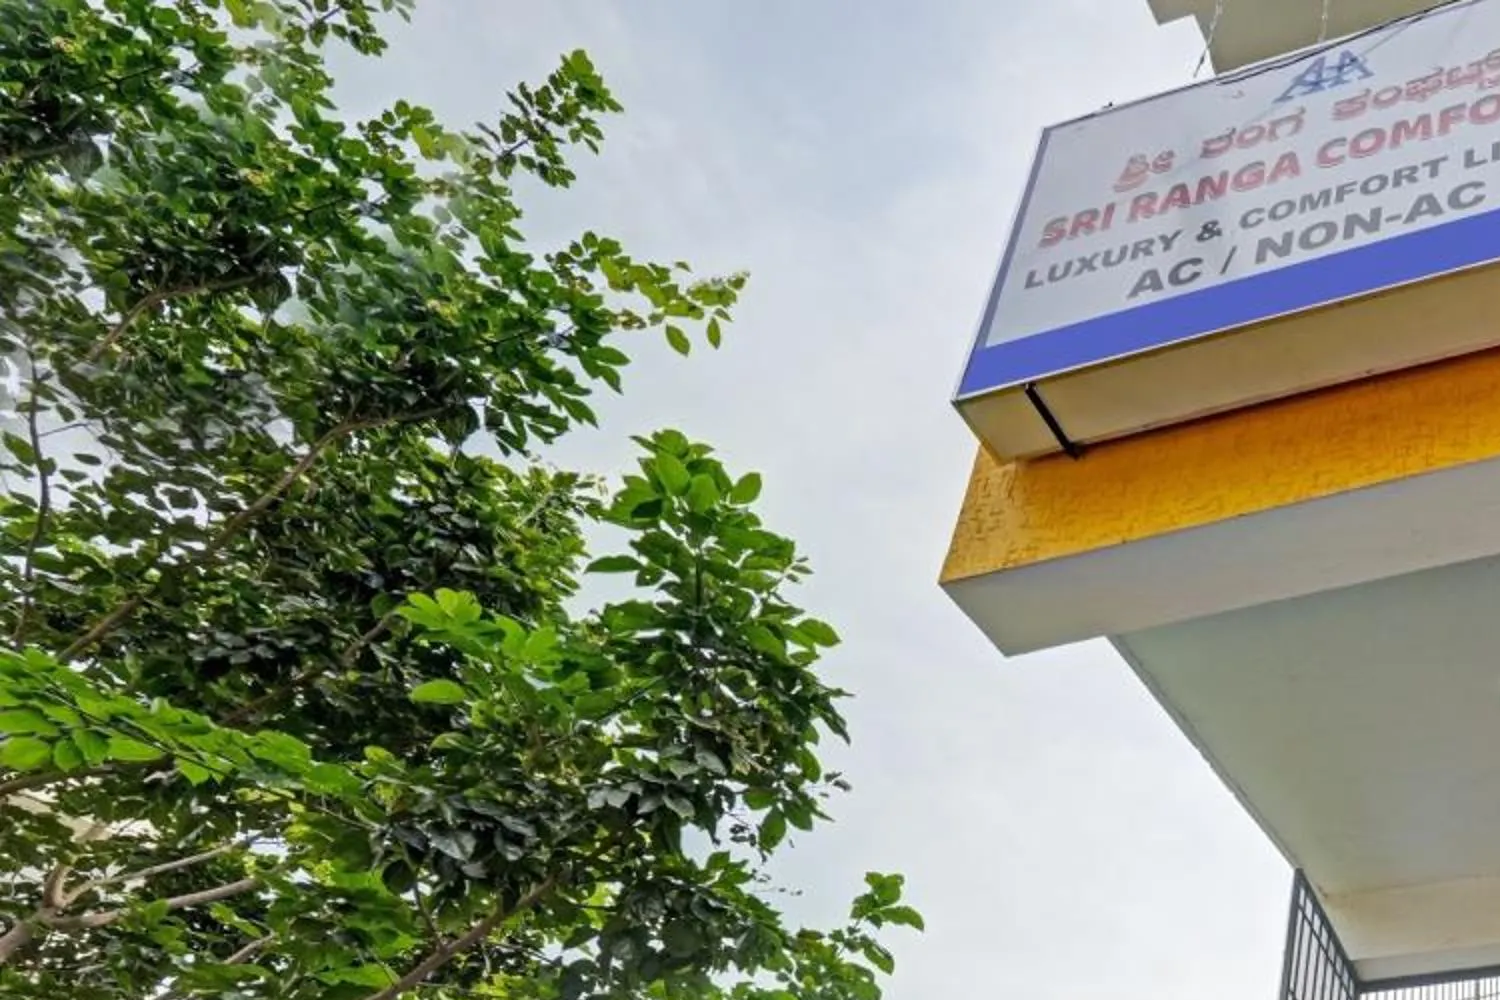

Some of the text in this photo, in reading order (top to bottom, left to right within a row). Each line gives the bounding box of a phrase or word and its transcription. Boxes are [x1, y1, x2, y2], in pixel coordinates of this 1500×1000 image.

[1038, 202, 1117, 249] SRI
[1126, 151, 1302, 224] RANGA
[1112, 150, 1176, 193] ಶ್ರೀ
[1199, 106, 1306, 159] ರಂಗ
[1024, 229, 1184, 290] LUXURY
[1195, 220, 1223, 243] &
[1238, 155, 1449, 229] COMFORT
[1126, 181, 1487, 300] AC / NON-AC
